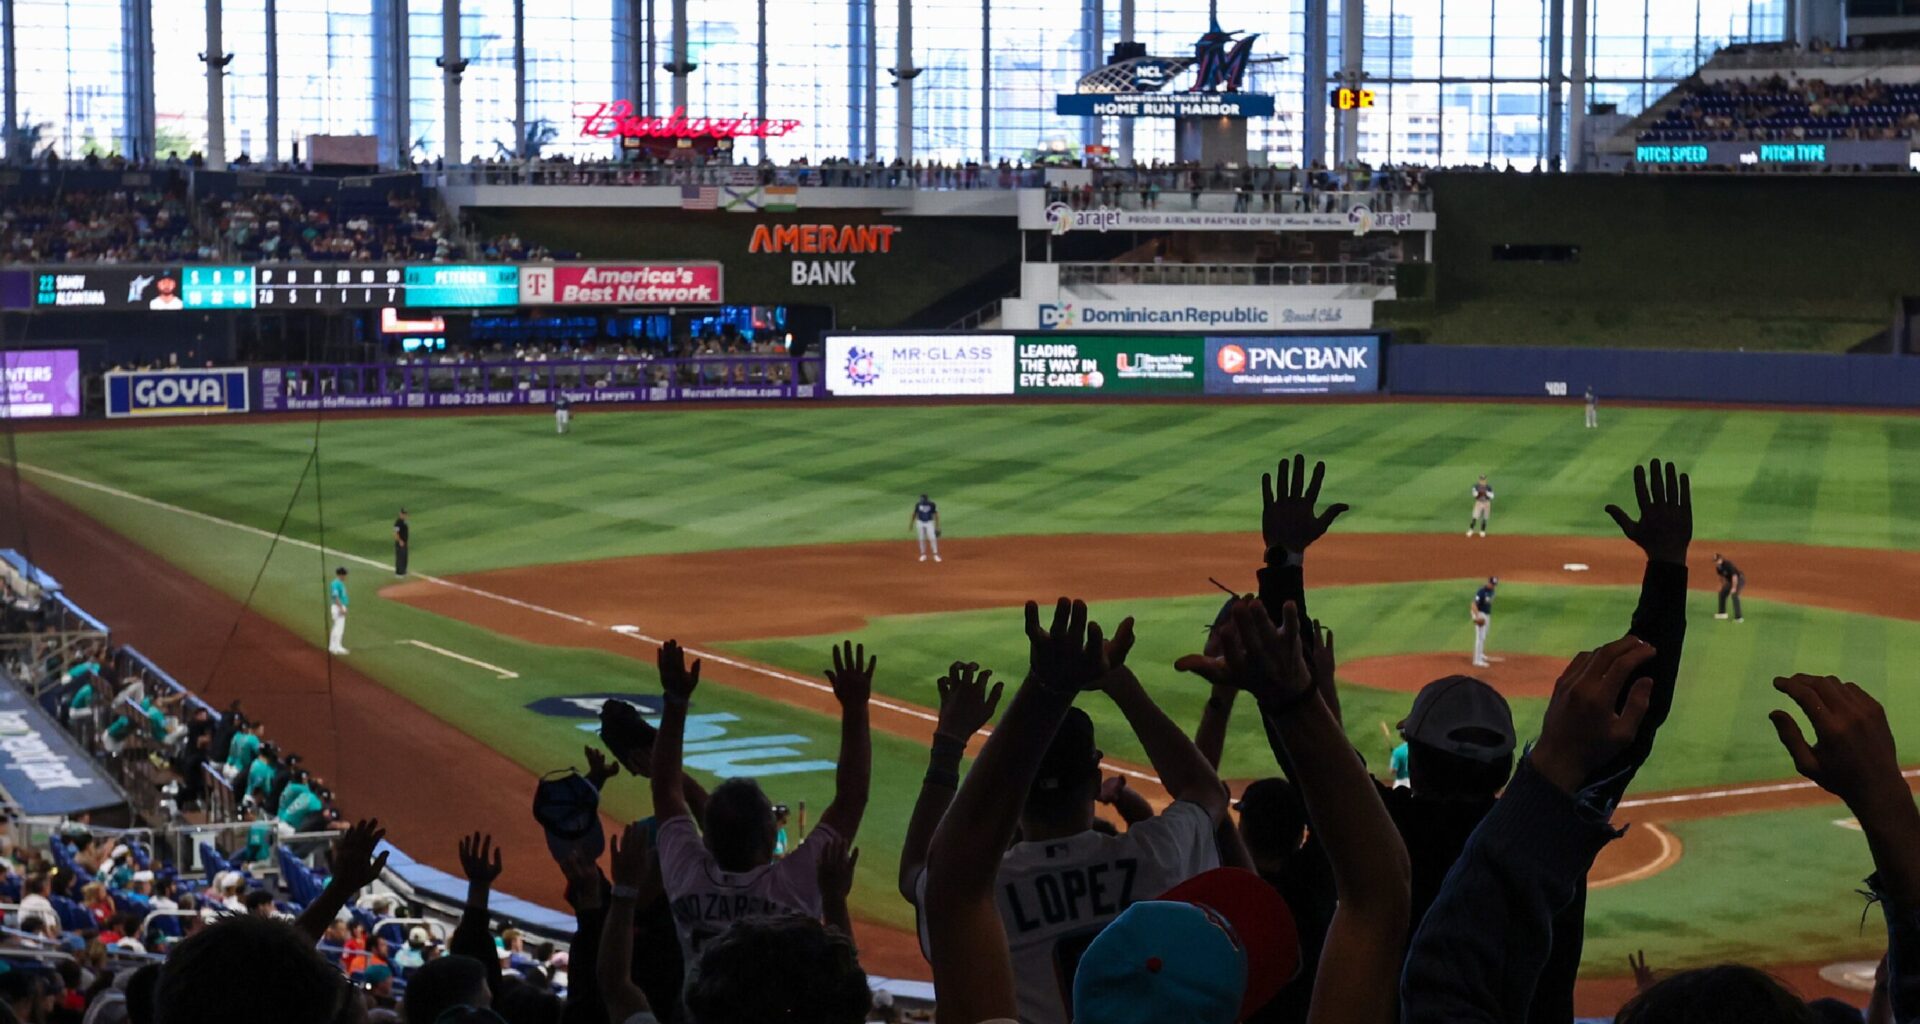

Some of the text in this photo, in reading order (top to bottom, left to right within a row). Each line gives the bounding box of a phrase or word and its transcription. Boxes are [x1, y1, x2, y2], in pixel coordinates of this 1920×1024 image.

[1136, 66, 1162, 77] NCL
[1114, 95, 1222, 103] NORWEGIAN CRUISE LINE
[574, 98, 799, 138] Budweiser
[1094, 104, 1240, 115] HOME RUN HARBOR
[1636, 146, 1671, 163] PITCH
[1672, 145, 1708, 162] SPEED
[1760, 144, 1826, 162] PITCH TYPE
[1077, 207, 1121, 230] arajet
[1128, 215, 1162, 224] PROUD
[1165, 215, 1201, 224] AIRLINE
[1204, 216, 1248, 225] PARTNER
[1249, 217, 1261, 225] OF
[1375, 208, 1411, 229] arajet
[748, 224, 895, 253] AMERANT
[580, 267, 694, 284] America's
[791, 260, 856, 285] BANK
[562, 284, 712, 302] Best Network
[1020, 345, 1077, 358] LEADING
[0, 366, 51, 382] NTERS
[1020, 359, 1097, 372] THE WAY IN
[1020, 374, 1084, 387] EYE CARE
[1545, 381, 1567, 396] 400
[135, 378, 221, 407] GOYA
[1005, 858, 1138, 933] LOPEZ
